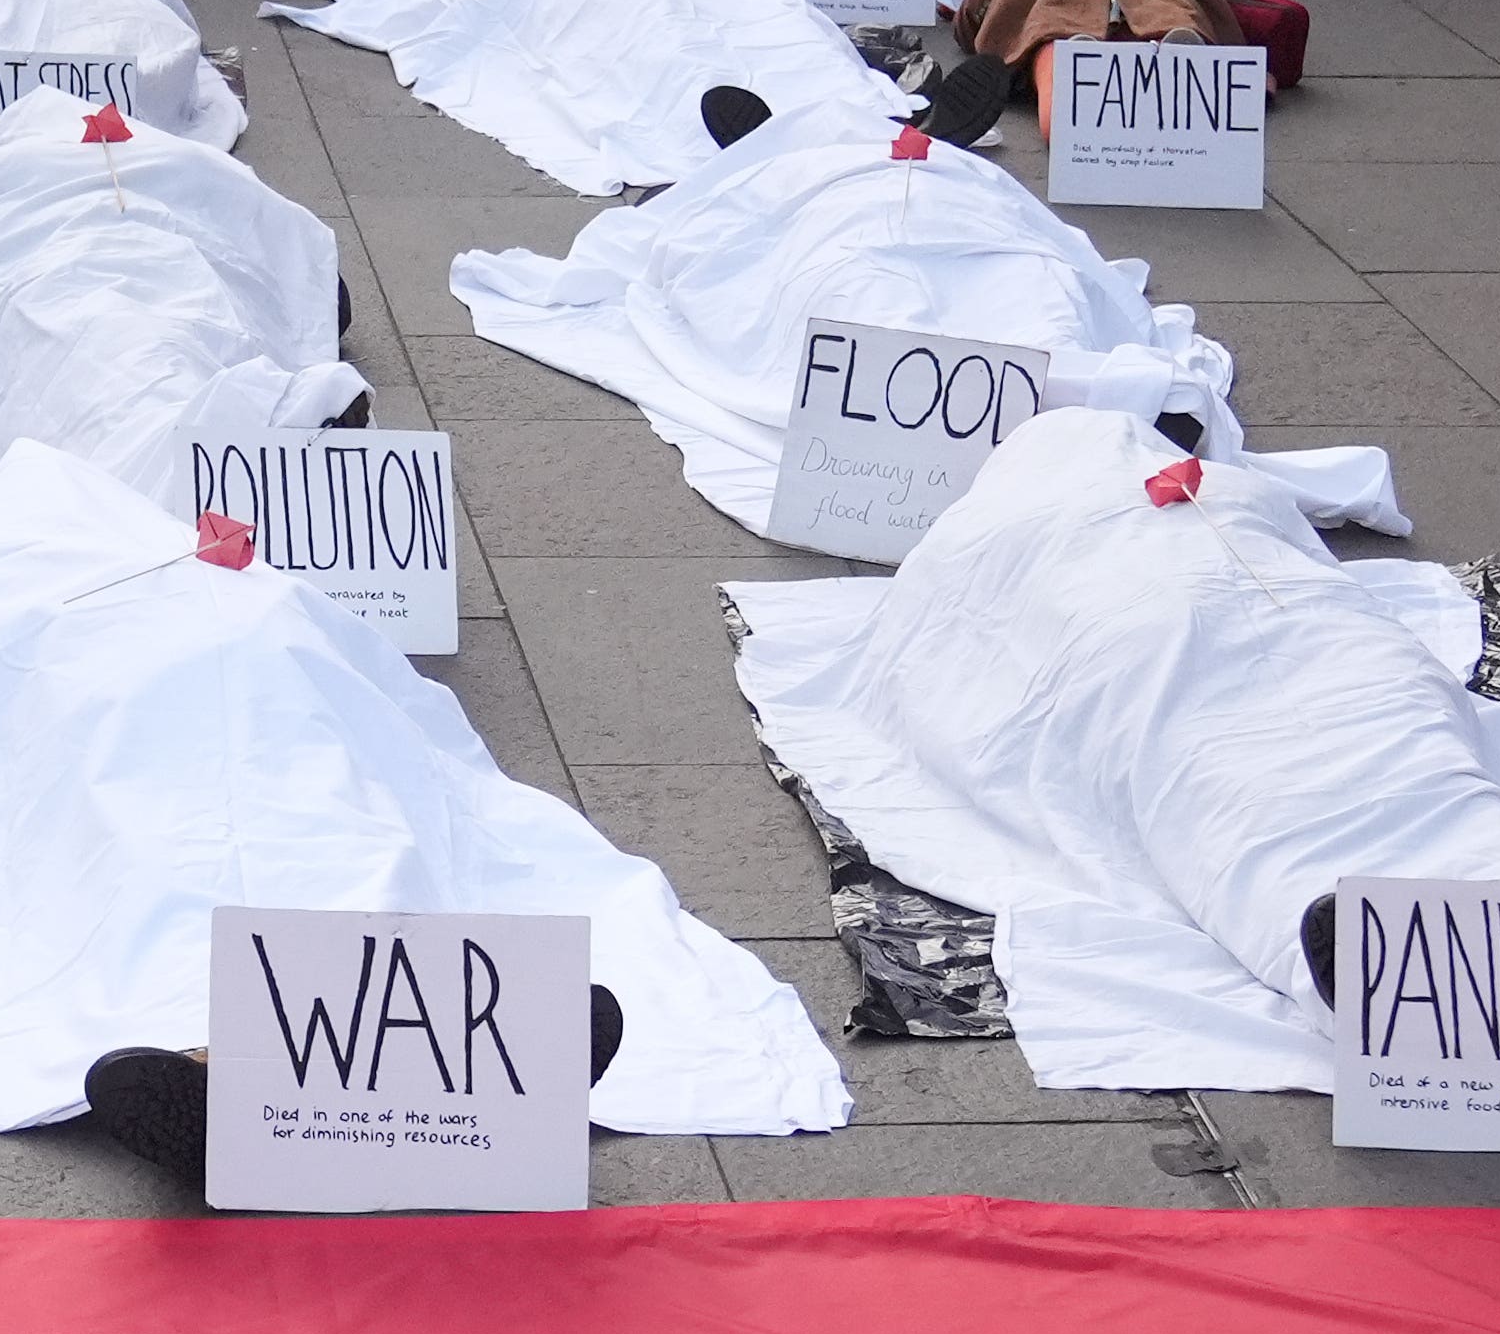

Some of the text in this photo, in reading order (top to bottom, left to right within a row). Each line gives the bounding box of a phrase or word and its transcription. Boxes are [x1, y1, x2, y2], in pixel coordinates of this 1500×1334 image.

[39, 62, 134, 117] TESS
[1072, 52, 1260, 133] FAMINE
[800, 332, 1040, 448] FLOOD
[800, 436, 951, 505] Drowning in
[191, 442, 448, 571] POLLUTION
[807, 490, 938, 531] flood wate
[325, 590, 406, 603] gravated by
[379, 607, 408, 619] heat
[250, 932, 527, 1096] WAR
[1368, 1071, 1405, 1089] Died
[1415, 1075, 1431, 1088] of
[1440, 1079, 1449, 1089] a
[1460, 1079, 1493, 1092] new
[262, 1104, 478, 1129] Died in one of the wars
[1380, 1097, 1451, 1111] intensive
[272, 1125, 492, 1151] for diminishing resources
